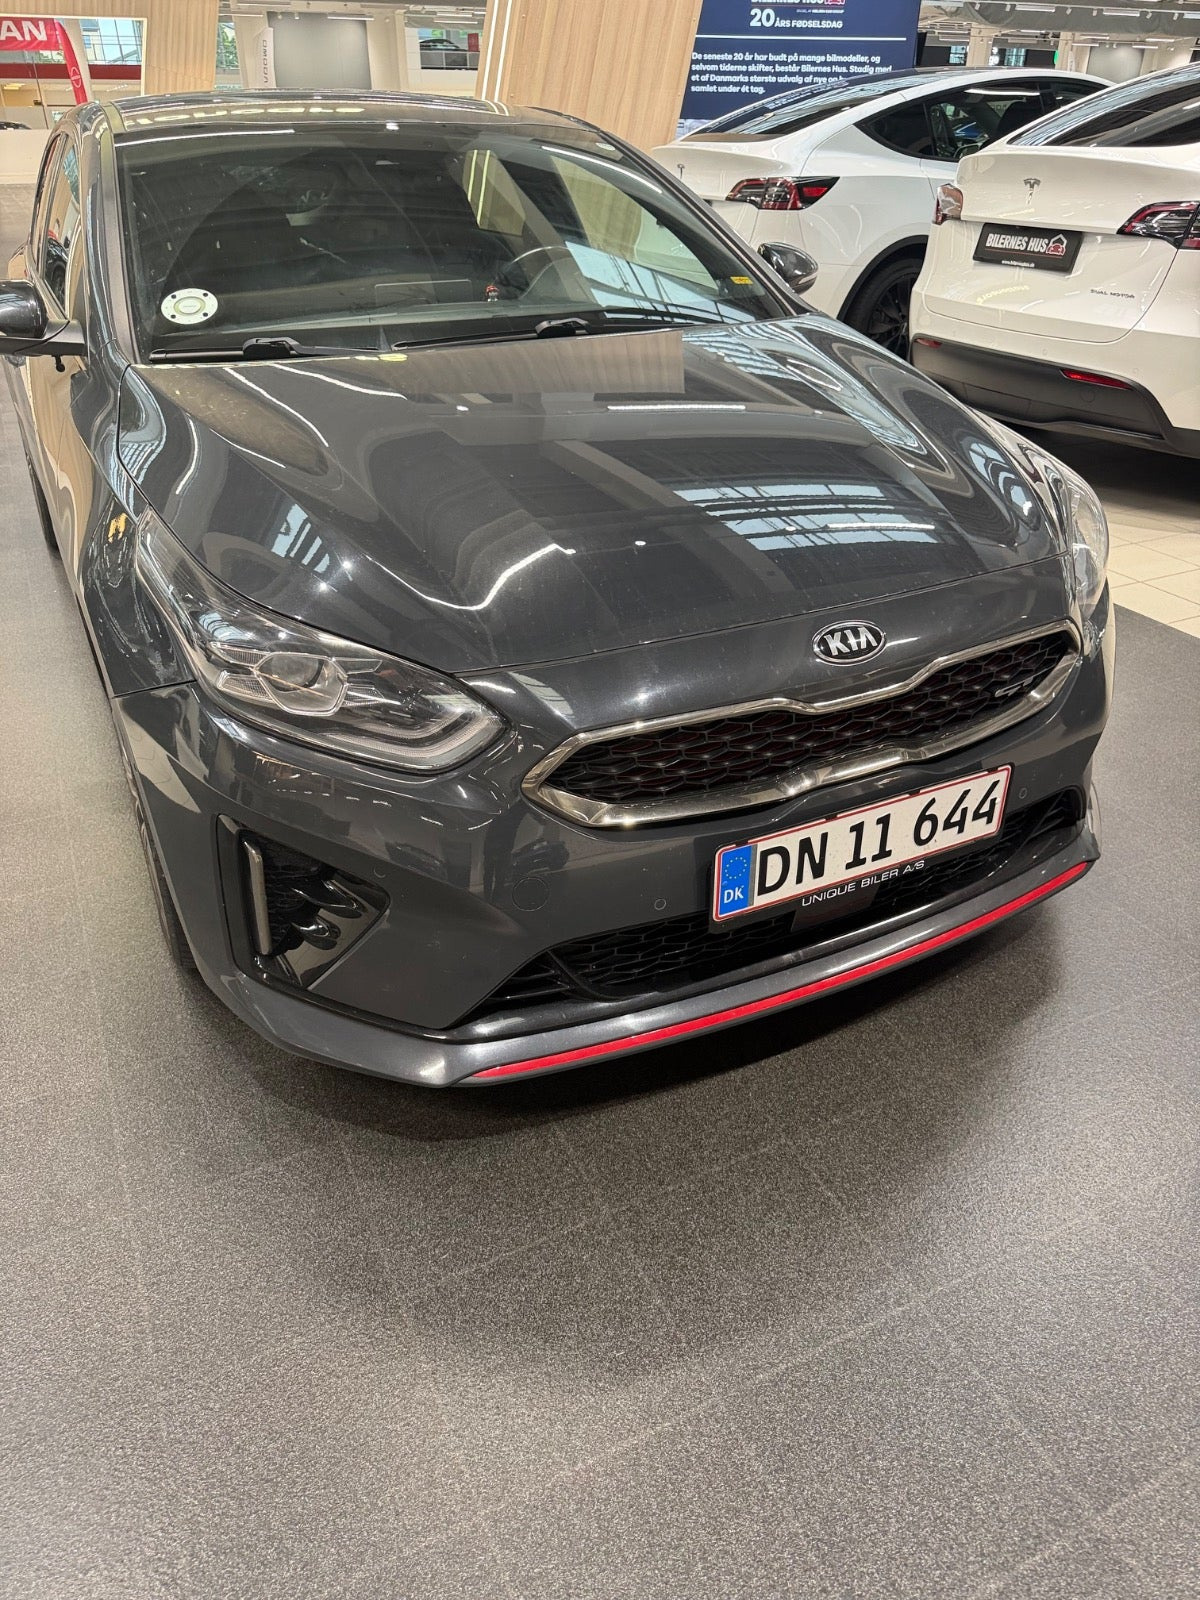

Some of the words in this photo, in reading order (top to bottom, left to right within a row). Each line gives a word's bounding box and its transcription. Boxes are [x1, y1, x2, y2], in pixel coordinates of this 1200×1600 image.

[749, 8, 775, 27] 20
[775, 17, 791, 28] ÅRS
[791, 19, 843, 29] FØDSELSDAG
[0, 20, 48, 41] AN
[691, 52, 702, 60] De
[703, 52, 732, 60] seneste
[733, 52, 743, 60] 20
[744, 52, 753, 61] år
[754, 53, 768, 61] har
[769, 53, 787, 61] budt
[788, 53, 798, 62] på
[799, 54, 825, 63] mange
[827, 54, 869, 63] bilmodeller,
[691, 63, 719, 71] selvom
[719, 63, 747, 71] tiderne
[748, 63, 774, 72] skifter,
[775, 64, 800, 72] består
[801, 64, 831, 72] Bilernes
[832, 65, 848, 73] Hus.
[849, 65, 874, 74] Stadig
[875, 65, 892, 73] med
[691, 74, 700, 82] et
[700, 73, 709, 82] af
[710, 74, 748, 82] Danmarks
[749, 75, 776, 83] største
[777, 74, 803, 84] udvalg
[804, 75, 813, 83] af
[813, 76, 827, 84] nye
[691, 84, 717, 92] samlet
[718, 84, 740, 93] under
[741, 84, 749, 92] ét
[750, 85, 765, 94] tag.
[986, 233, 1028, 251] BILERNES
[1027, 237, 1049, 253] HUS
[824, 626, 878, 656] KIA
[757, 831, 829, 897] DN
[845, 812, 892, 870] 11
[913, 779, 1001, 846] 644
[802, 882, 856, 907] UNIQUE
[861, 868, 899, 889] BILER
[903, 859, 925, 874] A/S
[723, 886, 744, 903] DK
